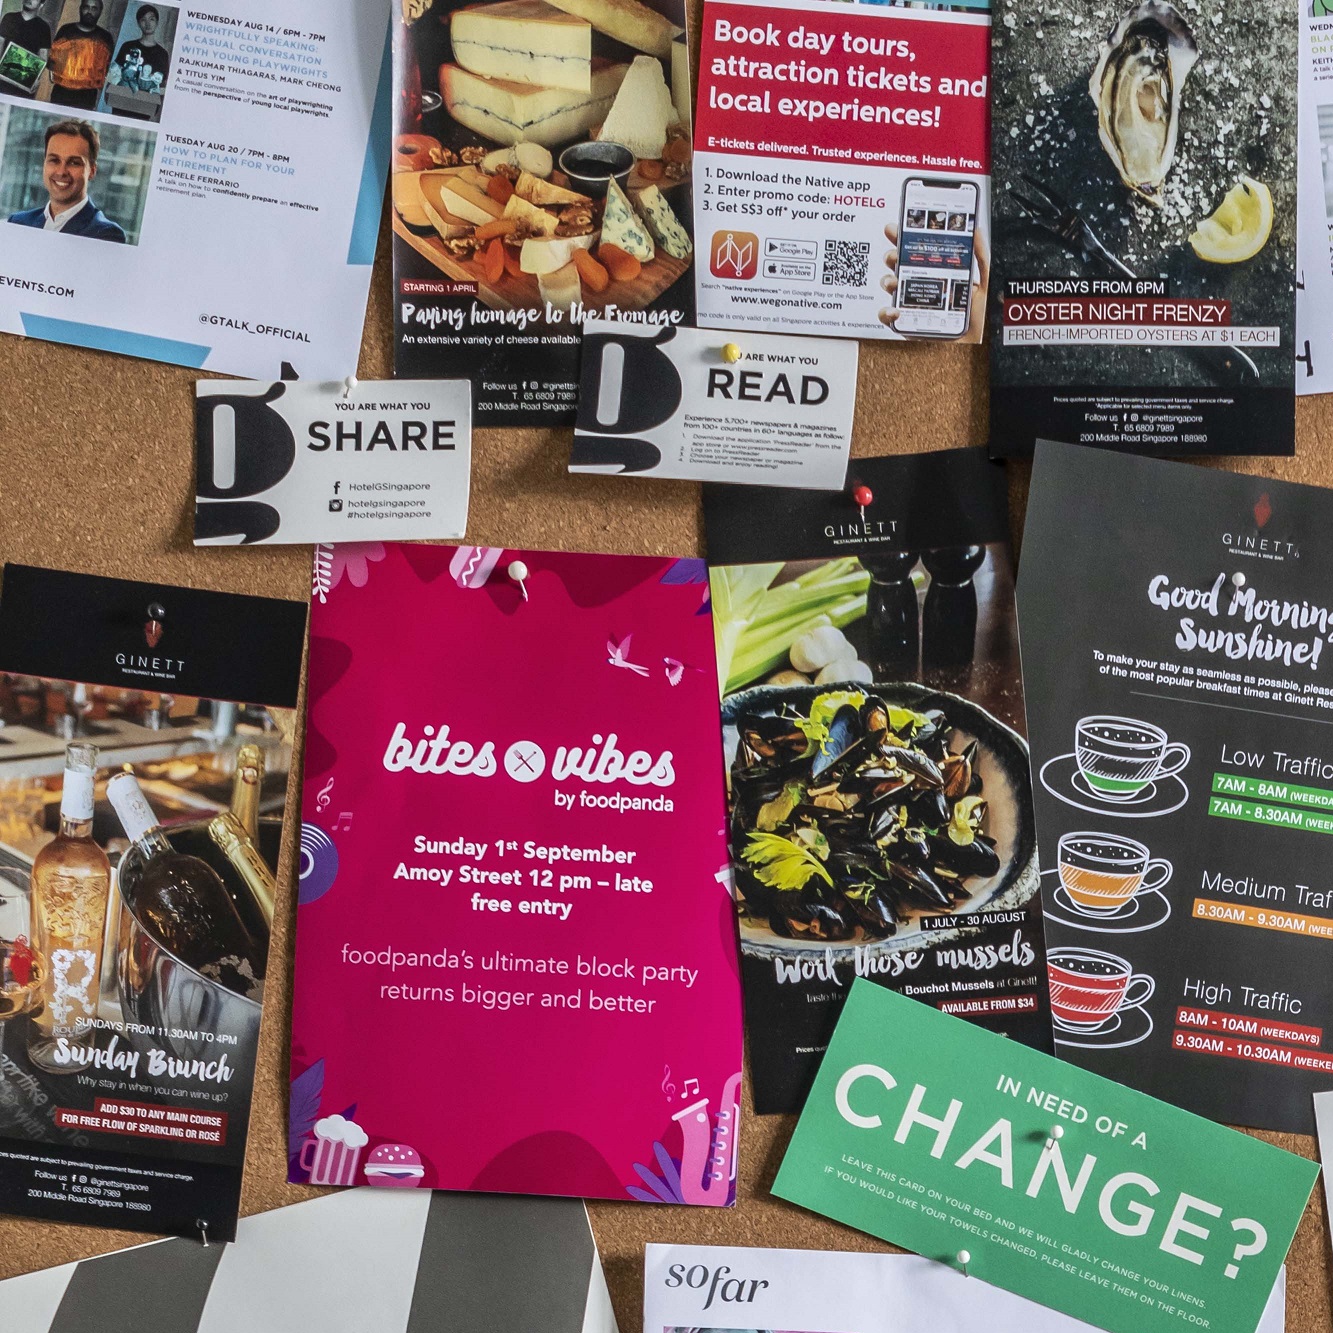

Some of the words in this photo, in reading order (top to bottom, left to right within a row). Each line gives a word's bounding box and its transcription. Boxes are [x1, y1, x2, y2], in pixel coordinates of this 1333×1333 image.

[714, 19, 782, 47] Book
[787, 25, 836, 56] day
[841, 31, 916, 62] tours,
[710, 55, 839, 86] attraction
[846, 64, 932, 93] tickets
[937, 75, 988, 98] and
[709, 86, 771, 114] local
[777, 97, 941, 128] experiences!
[160, 156, 227, 175] RETIREMENT
[703, 183, 714, 195] 2.
[717, 184, 751, 198] Enter
[753, 190, 794, 201] promo
[797, 192, 831, 205] code:
[833, 194, 886, 209] HOTELG
[403, 282, 445, 293] STARTING
[446, 284, 450, 292] 1
[452, 284, 476, 293] APRIL
[1008, 280, 1089, 294] THURSDAYS
[1093, 280, 1132, 294] FROM
[1135, 281, 1164, 294] 6PM
[401, 302, 466, 329] Paying
[471, 301, 541, 331] homage
[546, 301, 564, 325] to
[570, 301, 600, 325] the
[730, 295, 843, 310] www.wegonative.com
[1008, 303, 1083, 321] OYSTER
[1089, 303, 1148, 321] NIGHT
[1153, 303, 1227, 323] FRENZY
[200, 315, 311, 343] @GTALK_OFFICIAL
[1008, 327, 1134, 345] FRENCH-IMPORTED
[1136, 328, 1198, 342] OYSTERS
[1201, 330, 1217, 342] AT
[1220, 329, 1234, 343] $1
[1239, 330, 1276, 342] EACH
[706, 367, 830, 406] READ
[334, 402, 355, 411] YOU
[357, 402, 377, 411] ARE
[379, 402, 408, 411] WHAT
[410, 402, 431, 411] YOU
[306, 420, 456, 452] SHARE
[349, 482, 431, 492] HotelGSingapore
[347, 499, 426, 509] hotelgsingapore
[347, 510, 432, 520] #hotelgsingapore
[824, 520, 897, 538] GINETT
[1222, 532, 1294, 554] GINETT
[1148, 572, 1226, 617] Good
[1175, 617, 1323, 670] Sunshine!
[115, 652, 185, 672] GINETT
[383, 722, 497, 777] bites
[551, 733, 676, 787] vibes
[1221, 743, 1265, 769] Low
[554, 789, 576, 811] by
[579, 789, 674, 814] foodpanda
[413, 835, 488, 861] Sunday
[523, 840, 637, 865] September
[1201, 870, 1286, 902] Medium
[470, 892, 513, 913] free
[518, 898, 573, 921] entry
[774, 947, 843, 986] Work
[854, 944, 924, 978] those
[936, 928, 1035, 971] mussels
[941, 1001, 988, 1014] AVAILABLE
[990, 998, 1016, 1011] FROM
[1017, 997, 1034, 1009] $34
[1183, 977, 1232, 1005] High
[1240, 985, 1302, 1015] Traffic
[52, 1033, 140, 1079] Sunday
[146, 1048, 235, 1084] Brunch
[995, 1074, 1022, 1098] IN
[1026, 1086, 1089, 1124] NEED
[1095, 1115, 1129, 1138] OF
[1131, 1131, 1147, 1151] A
[835, 1063, 1268, 1278] CHANGE?
[664, 1263, 769, 1310] sofar
